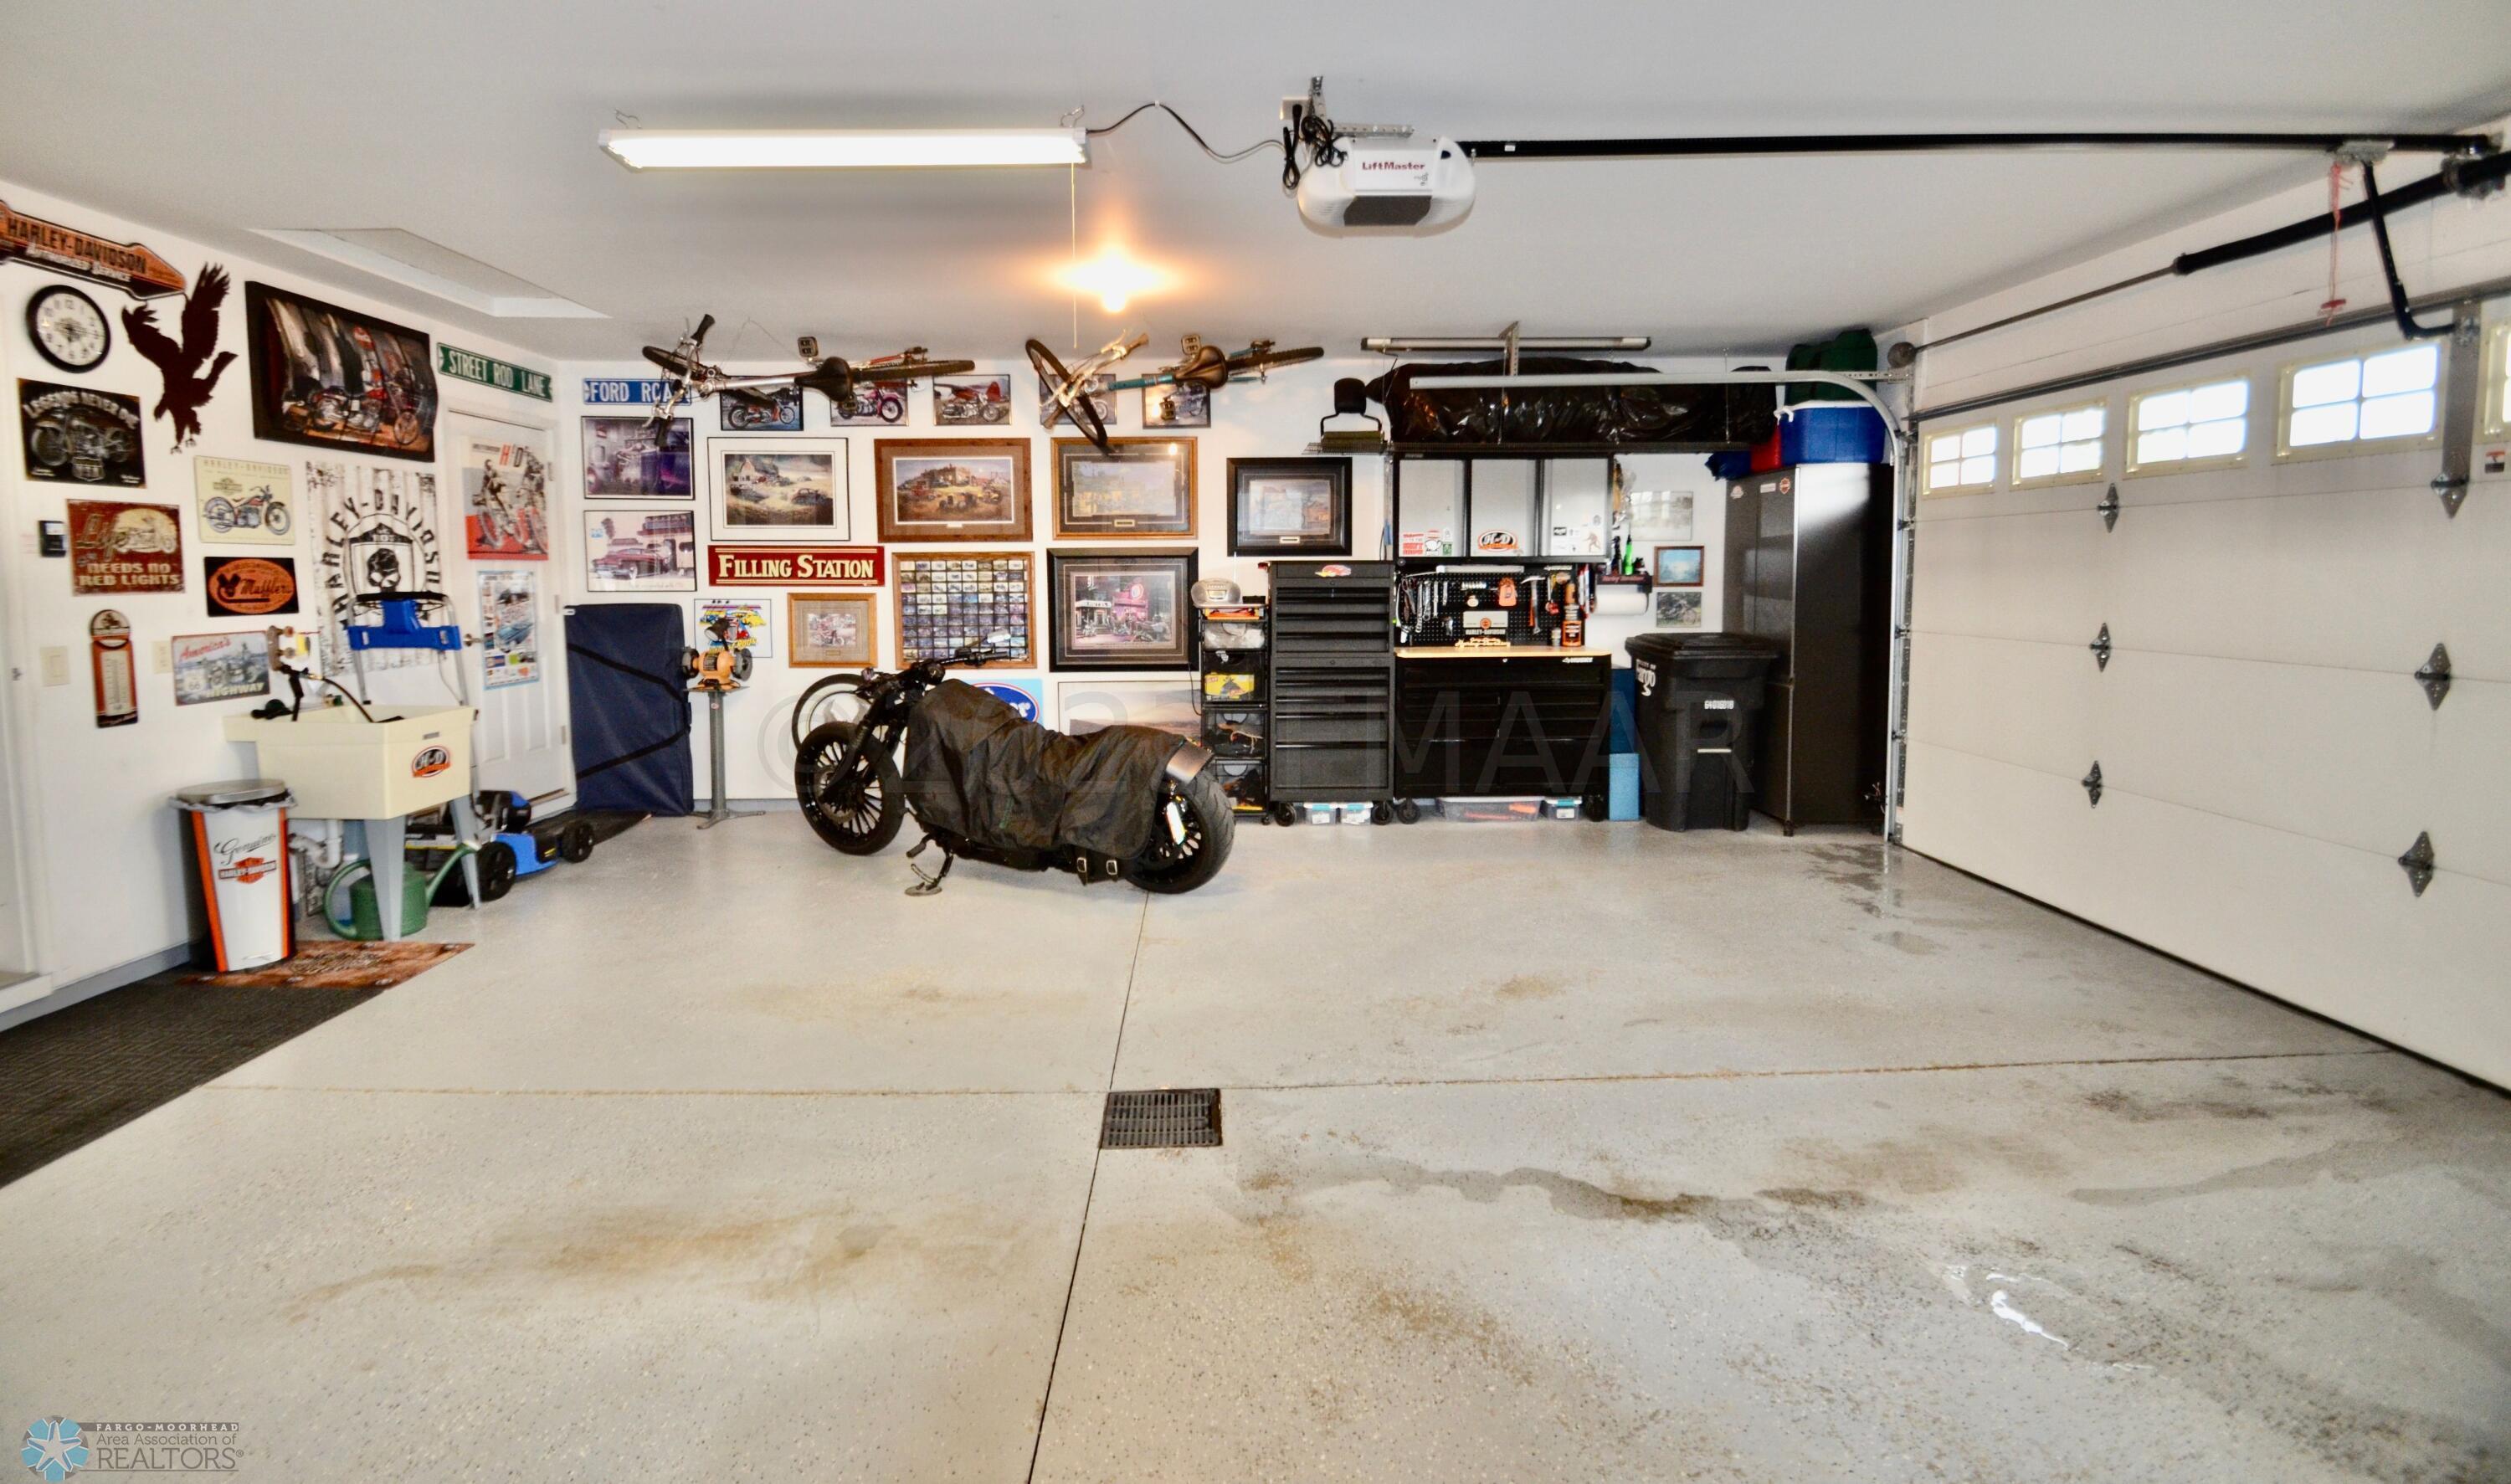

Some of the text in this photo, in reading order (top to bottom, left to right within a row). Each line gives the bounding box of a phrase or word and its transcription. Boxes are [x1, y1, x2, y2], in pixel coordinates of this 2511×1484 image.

[1361, 161, 1426, 171] LiftMaster
[7, 216, 146, 275] HARLEY-DAVIDSON
[449, 349, 545, 397] STREET ROD LANE
[590, 382, 629, 402] FORD
[719, 554, 875, 578] FILLING STATION
[80, 574, 182, 586] RED LIGHTS
[205, 682, 264, 698] HIGHWAY
